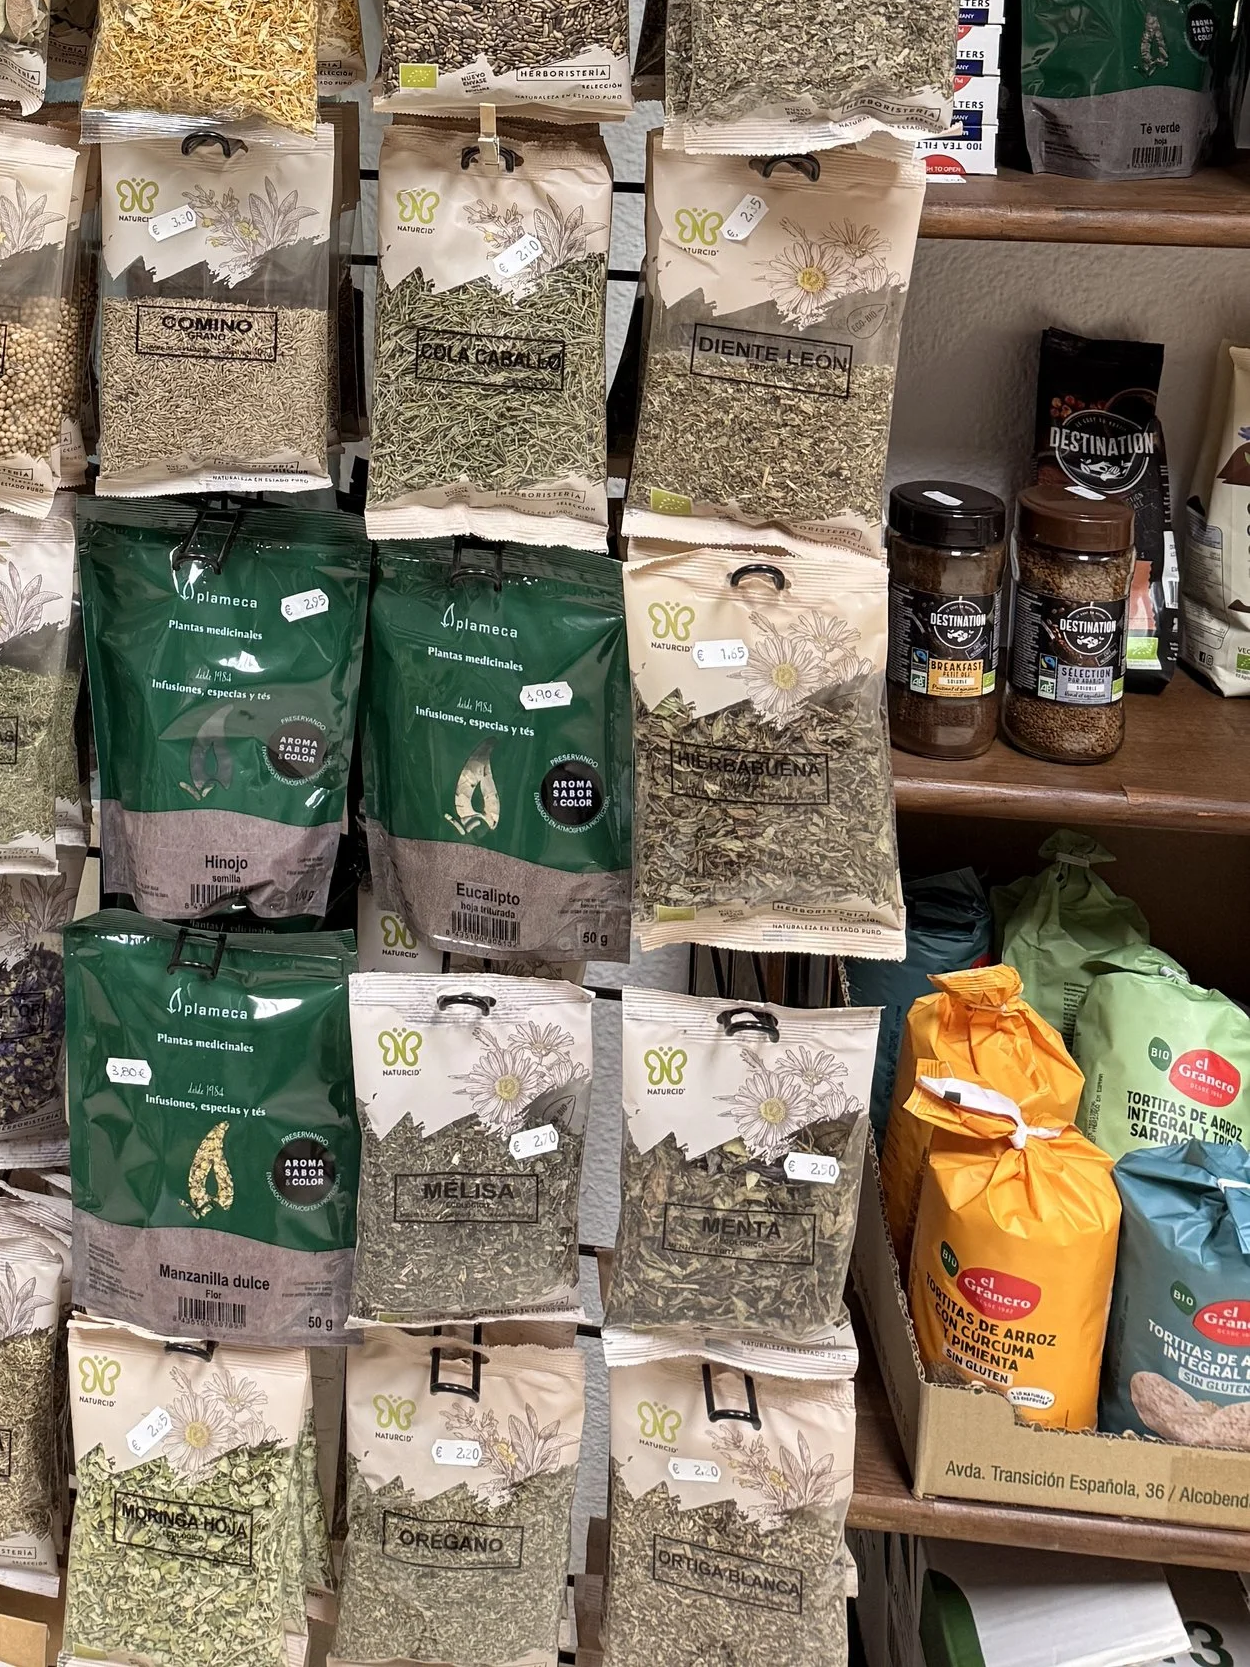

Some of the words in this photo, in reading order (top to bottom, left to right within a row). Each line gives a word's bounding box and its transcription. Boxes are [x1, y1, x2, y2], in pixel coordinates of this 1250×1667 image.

[520, 68, 606, 80] HERBORISTERÍA
[1141, 123, 1153, 134] Té
[1156, 123, 1180, 133] verde
[162, 315, 252, 333] COMINO
[421, 343, 470, 365] COLA
[476, 350, 561, 371] CABALLO
[698, 337, 779, 363] DIENTE
[786, 342, 848, 371] LEÓN
[1050, 426, 1154, 456] DESTINATION
[197, 592, 257, 609] plameca
[931, 614, 986, 627] DESTINATION
[930, 661, 982, 672] BREAKFAST
[1061, 667, 1111, 678] SÉLECTION
[676, 752, 821, 778] HIERBABUENA
[553, 780, 592, 789] AROMA
[553, 789, 593, 798] SABOR
[559, 799, 592, 807] COLOR
[205, 855, 248, 871] Hinojo
[212, 874, 241, 883] semilla
[456, 884, 520, 906] Eucalipto
[461, 901, 478, 915] hoja
[480, 904, 515, 919] triturada
[0, 1003, 41, 1020] FLOR
[1151, 1046, 1169, 1060] BIO
[1179, 1065, 1234, 1094] Granero
[1128, 1091, 1186, 1118] TORTITAS
[1190, 1108, 1206, 1124] DE
[1210, 1113, 1242, 1142] ARROZ
[789, 1160, 795, 1172] €
[423, 1181, 514, 1200] MELISA
[702, 1217, 781, 1239] MENTA
[160, 1264, 228, 1288] Manzanilla
[233, 1275, 270, 1291] dulce
[206, 1290, 222, 1300] Flor
[963, 1277, 1032, 1310] Granero
[926, 1271, 975, 1325] TORTITAS
[978, 1318, 1000, 1337] DE
[1003, 1327, 1057, 1347] ARROZ
[935, 1302, 958, 1332] CON
[961, 1325, 1035, 1360] CÚRCUMA
[942, 1324, 950, 1338] Y
[951, 1334, 1019, 1372] PIMIENTA
[946, 1348, 963, 1366] SIN
[965, 1359, 1009, 1385] GLUTEN
[945, 1461, 985, 1481] Avda.
[992, 1465, 1065, 1489] Transición
[1070, 1475, 1140, 1499] Española,
[1145, 1483, 1164, 1500] 36
[121, 1503, 196, 1529] MORINGA
[202, 1516, 247, 1536] HOJA
[658, 1550, 724, 1581] ORTIGA
[728, 1564, 801, 1597] BLANCA
